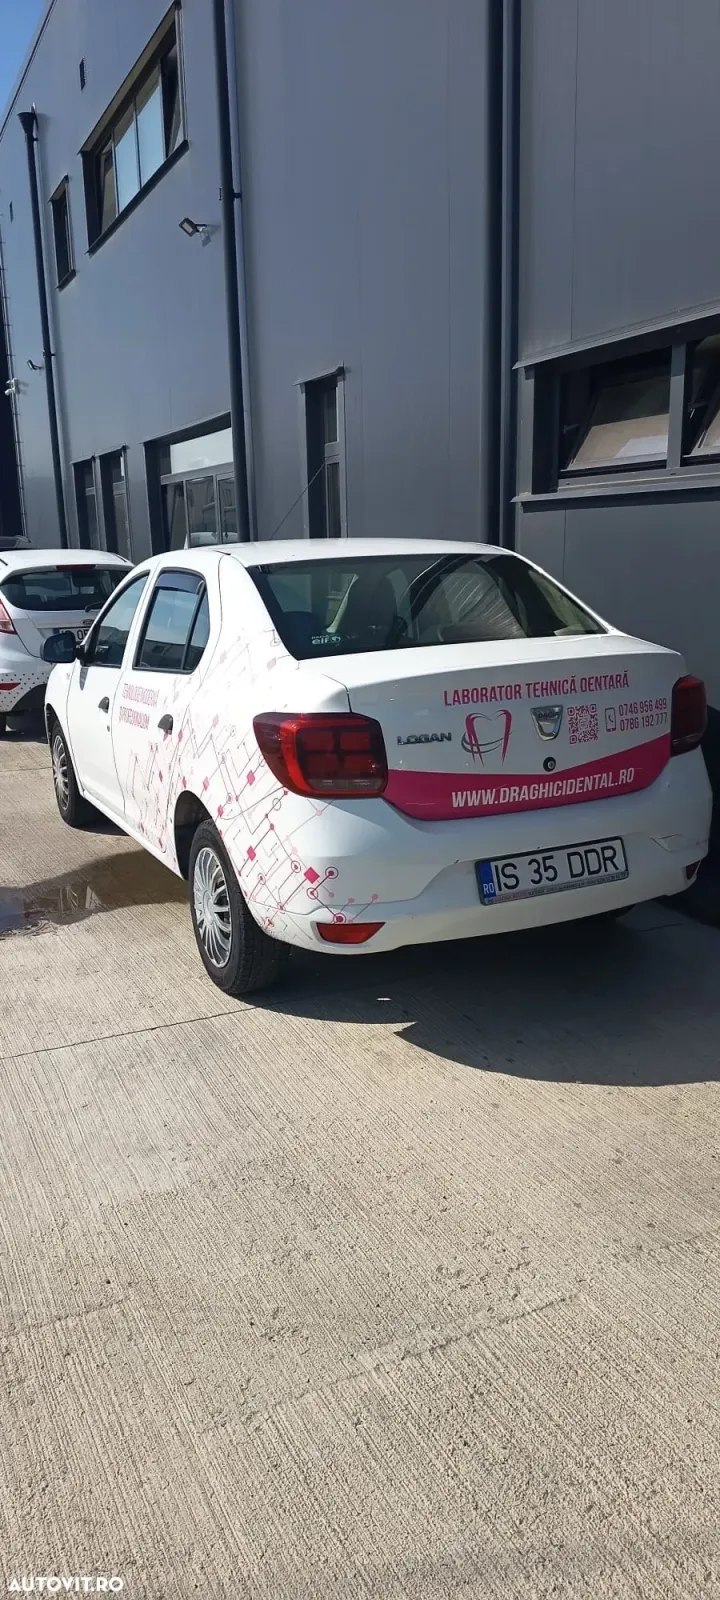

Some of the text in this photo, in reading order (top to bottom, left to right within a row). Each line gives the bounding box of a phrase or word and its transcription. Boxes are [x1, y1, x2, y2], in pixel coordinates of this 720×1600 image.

[443, 670, 629, 706] LABORATOR TEHNICĂ DENTARĂ
[618, 697, 667, 716] 0746 956 499
[619, 712, 667, 731] 0786 192 777
[397, 732, 452, 745] LOGAN
[451, 767, 635, 808] WWW.DRAGHICIDENTAL.RO
[494, 862, 520, 891] IS
[528, 855, 558, 885] 35
[567, 845, 620, 879] DDR
[483, 883, 495, 895] RO
